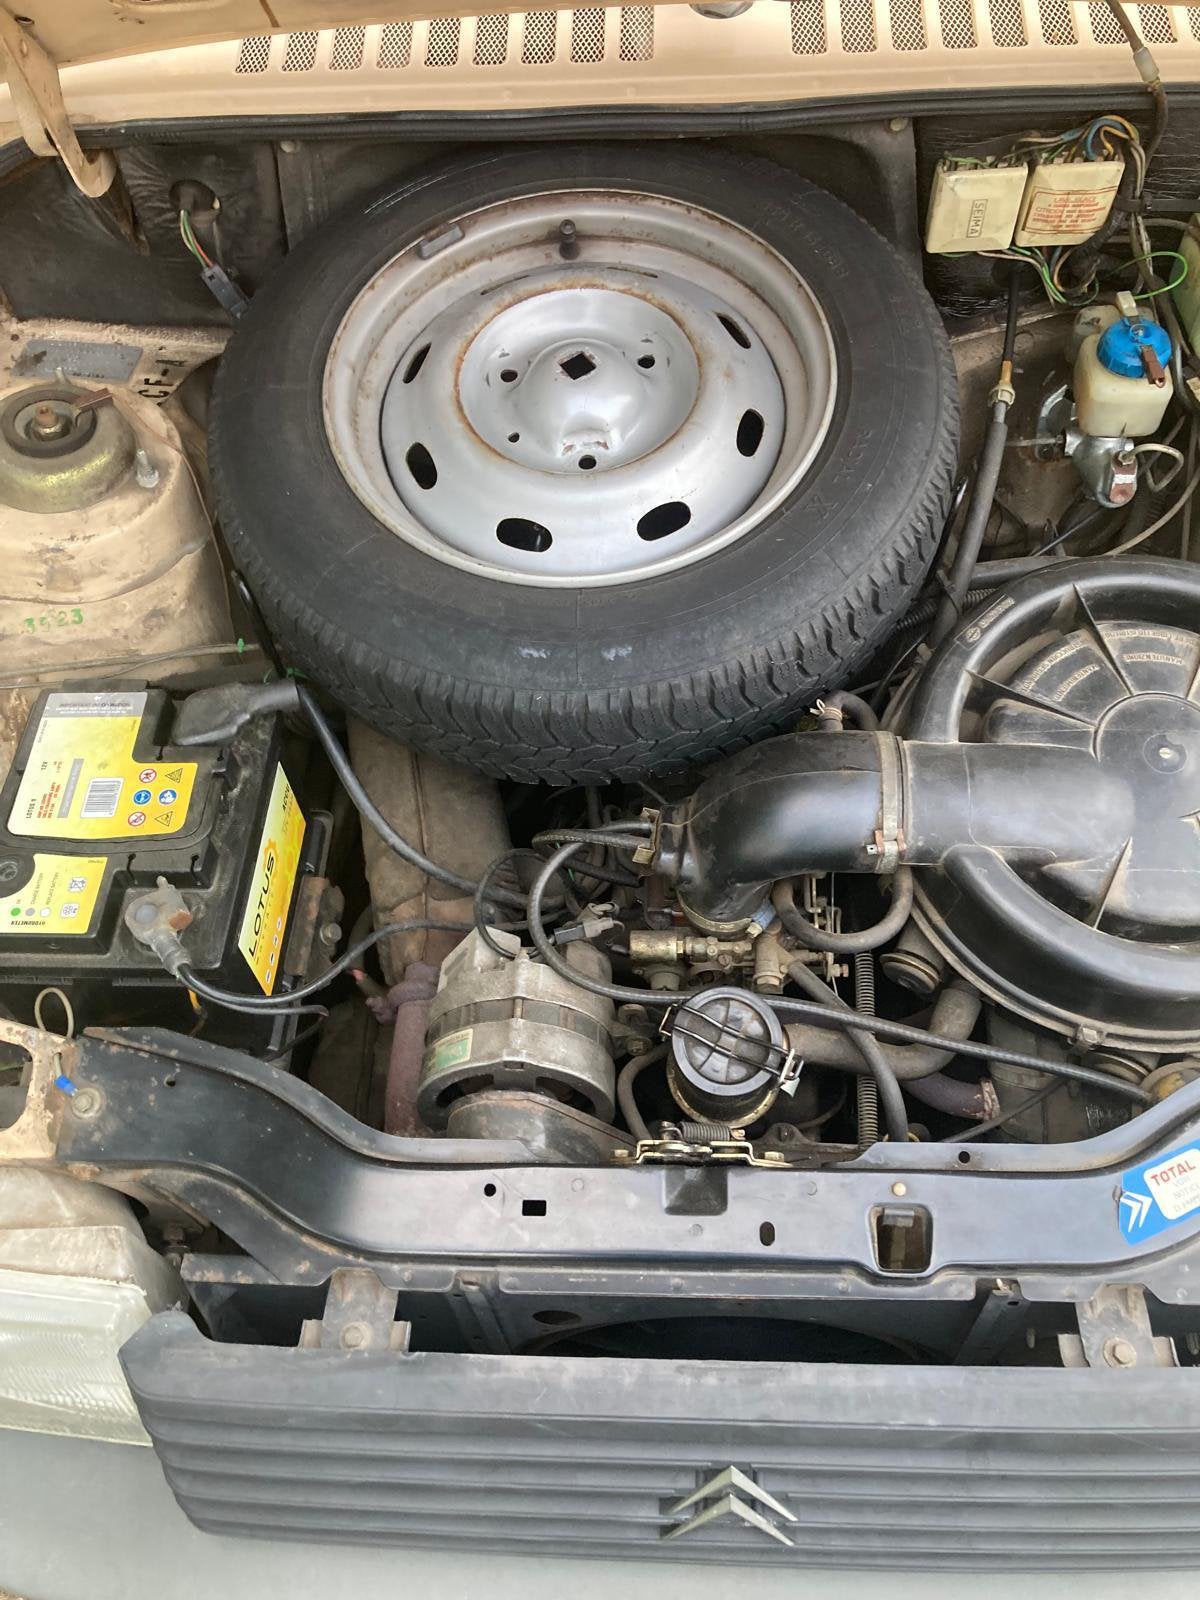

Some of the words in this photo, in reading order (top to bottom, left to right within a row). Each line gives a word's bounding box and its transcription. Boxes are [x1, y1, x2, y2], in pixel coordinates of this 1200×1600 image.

[969, 202, 985, 235] SEIMA
[248, 853, 274, 957] LOTUS
[1150, 1160, 1196, 1186] TOTAL
